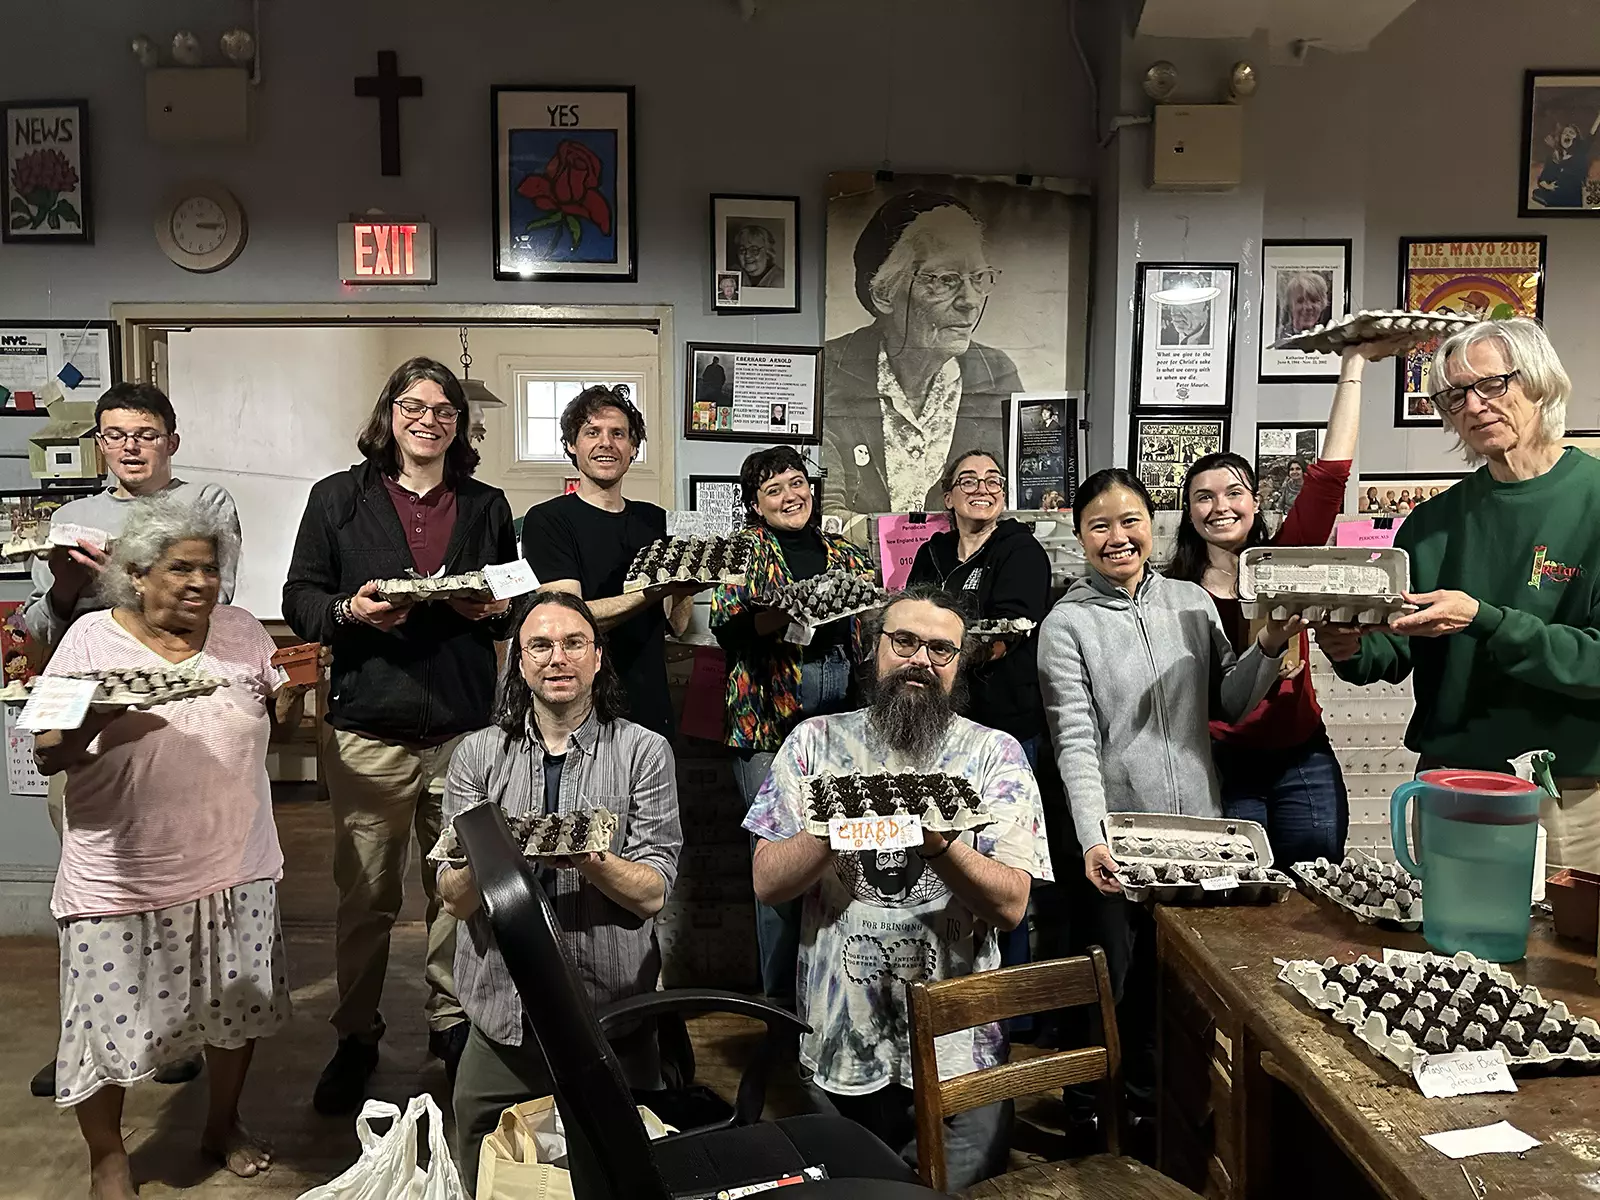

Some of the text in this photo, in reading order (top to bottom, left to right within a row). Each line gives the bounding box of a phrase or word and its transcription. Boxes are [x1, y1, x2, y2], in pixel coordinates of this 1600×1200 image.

[547, 104, 580, 127] YES
[15, 116, 73, 145] NEWS
[354, 224, 418, 276] EXIT
[1424, 243, 1444, 256] DE
[1449, 242, 1495, 256] MAYO
[1500, 241, 1537, 255] 2012
[1411, 257, 1449, 267] TOMA
[1454, 257, 1481, 267] LAS
[1, 335, 28, 346] NYC
[1068, 457, 1076, 473] DAY
[900, 557, 914, 566] 010
[838, 820, 899, 840] CHARD
[862, 920, 878, 930] FOR
[880, 920, 923, 932] BRINGING
[946, 918, 960, 941] US
